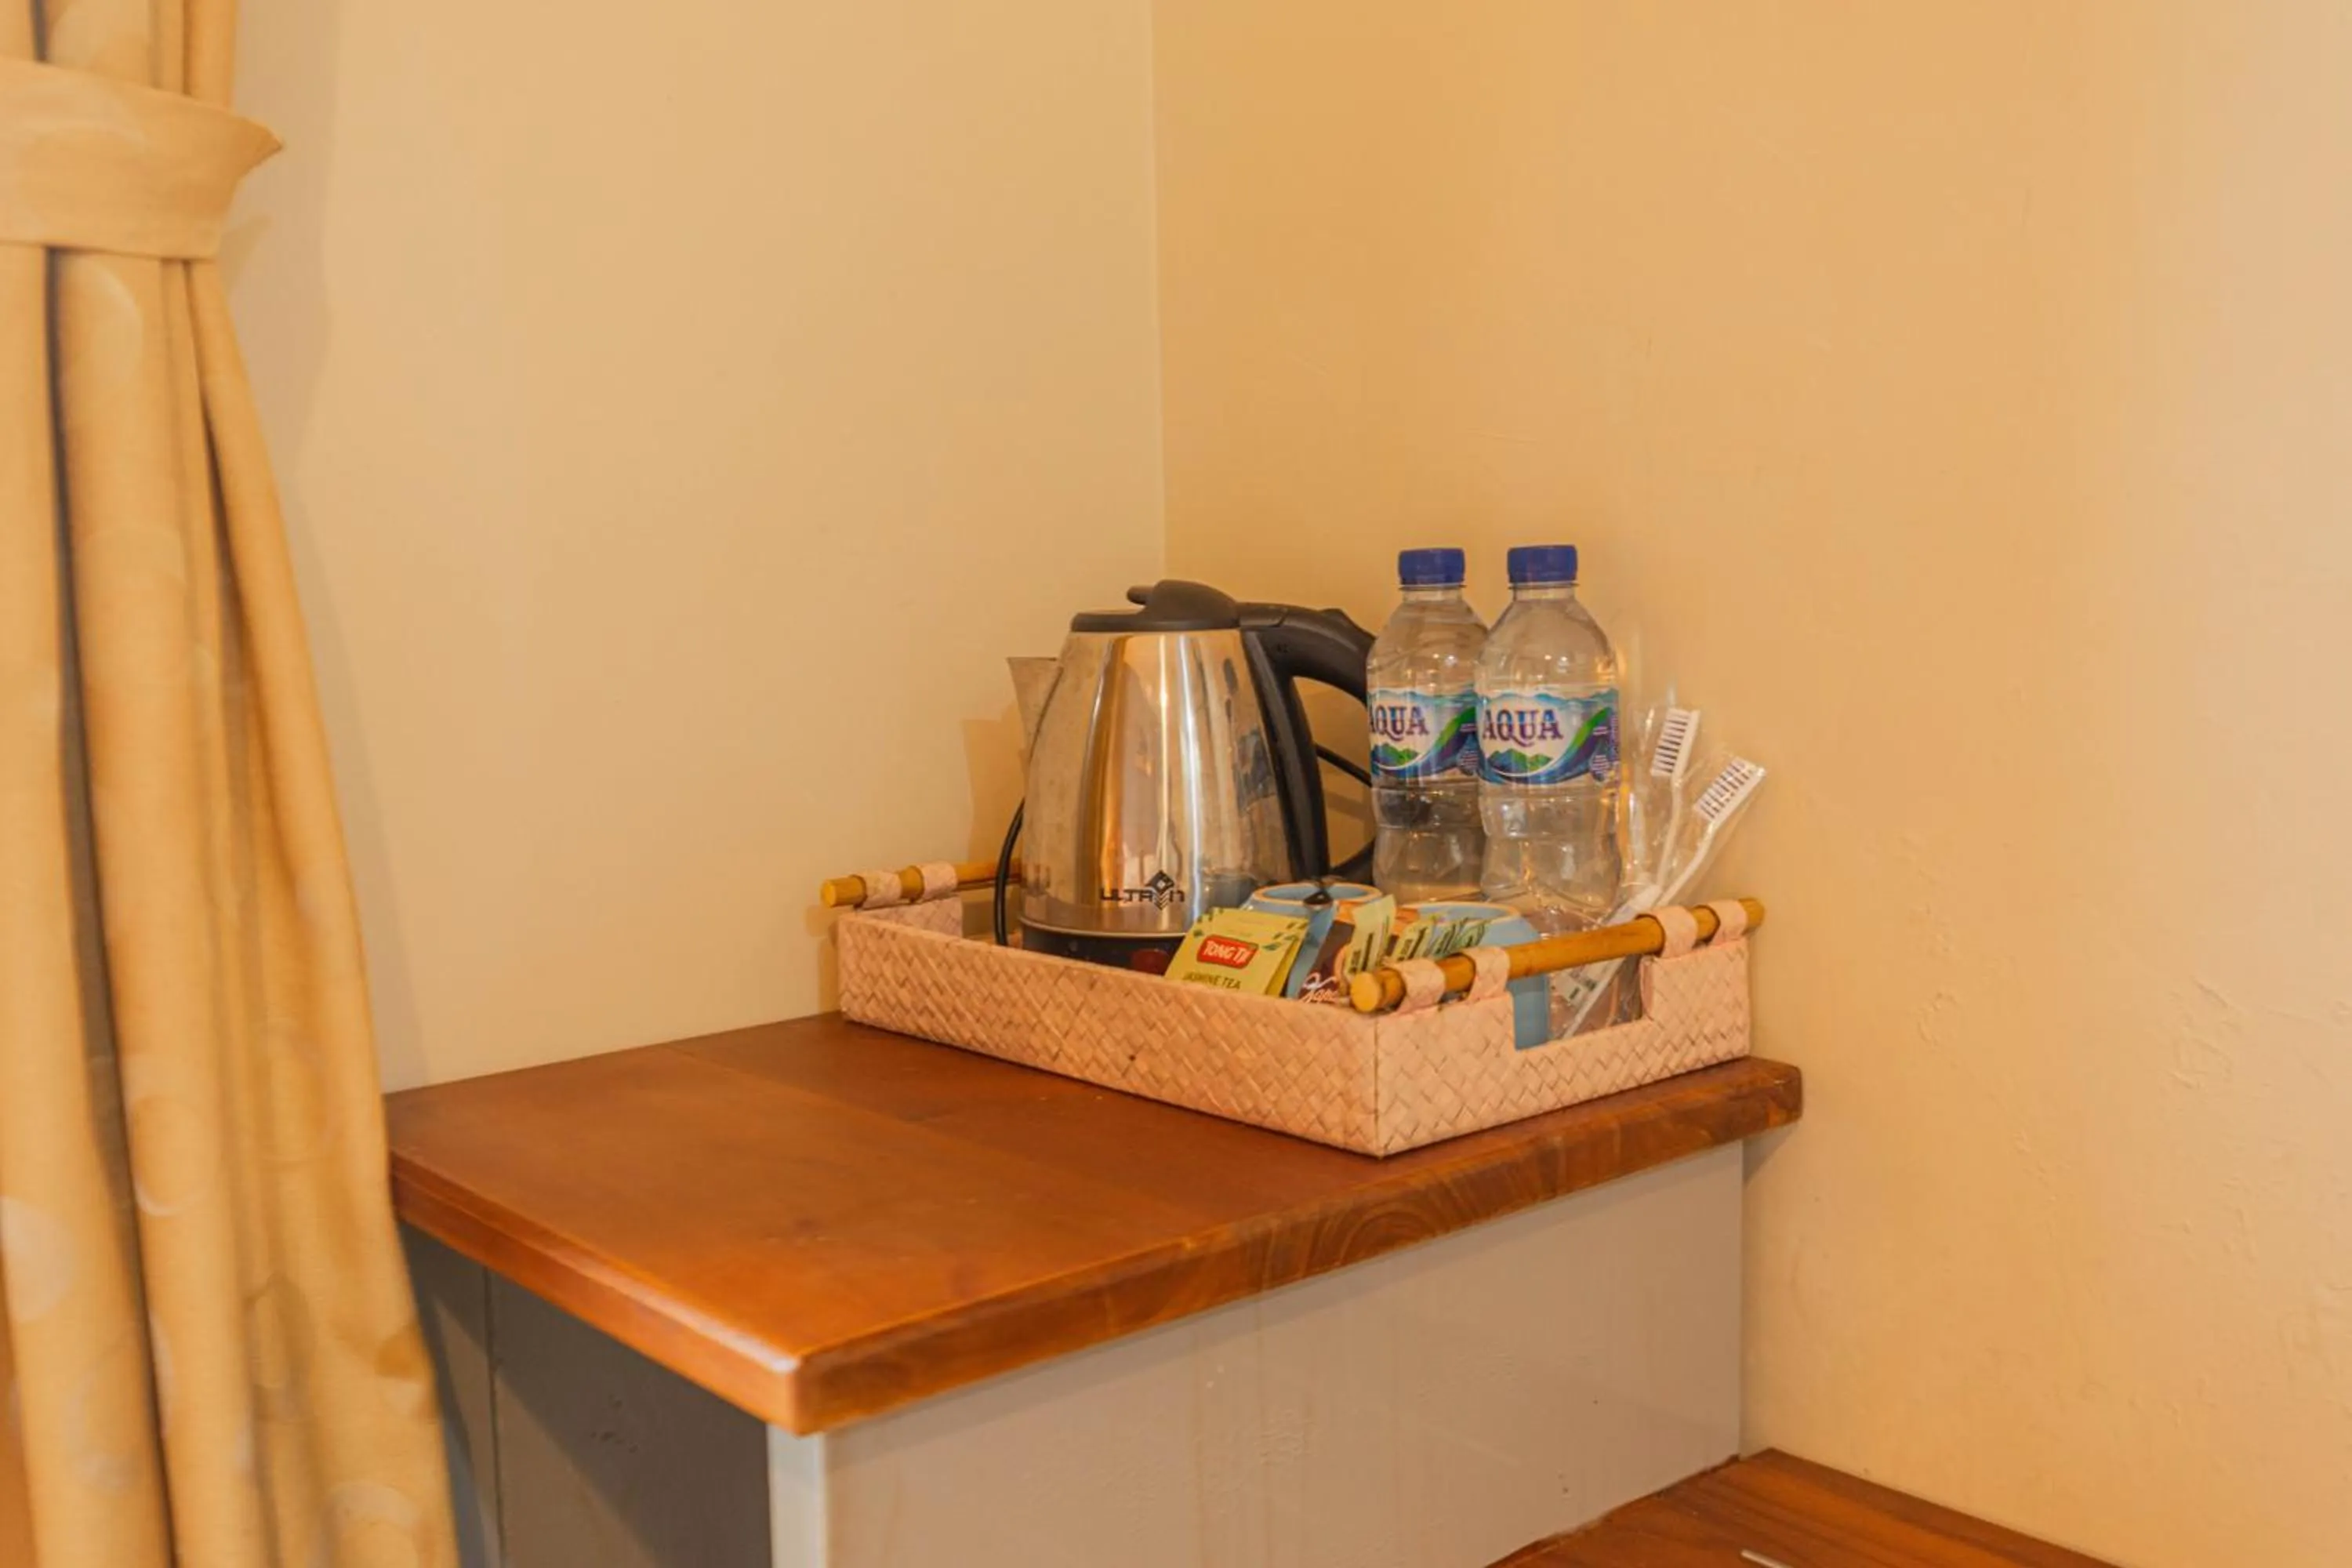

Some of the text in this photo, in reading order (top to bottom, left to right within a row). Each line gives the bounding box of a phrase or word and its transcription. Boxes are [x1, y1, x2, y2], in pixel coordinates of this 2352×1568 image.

[1483, 708, 1563, 747] AQUA
[1202, 940, 1237, 960] TONG
[1222, 977, 1241, 989] TEA
